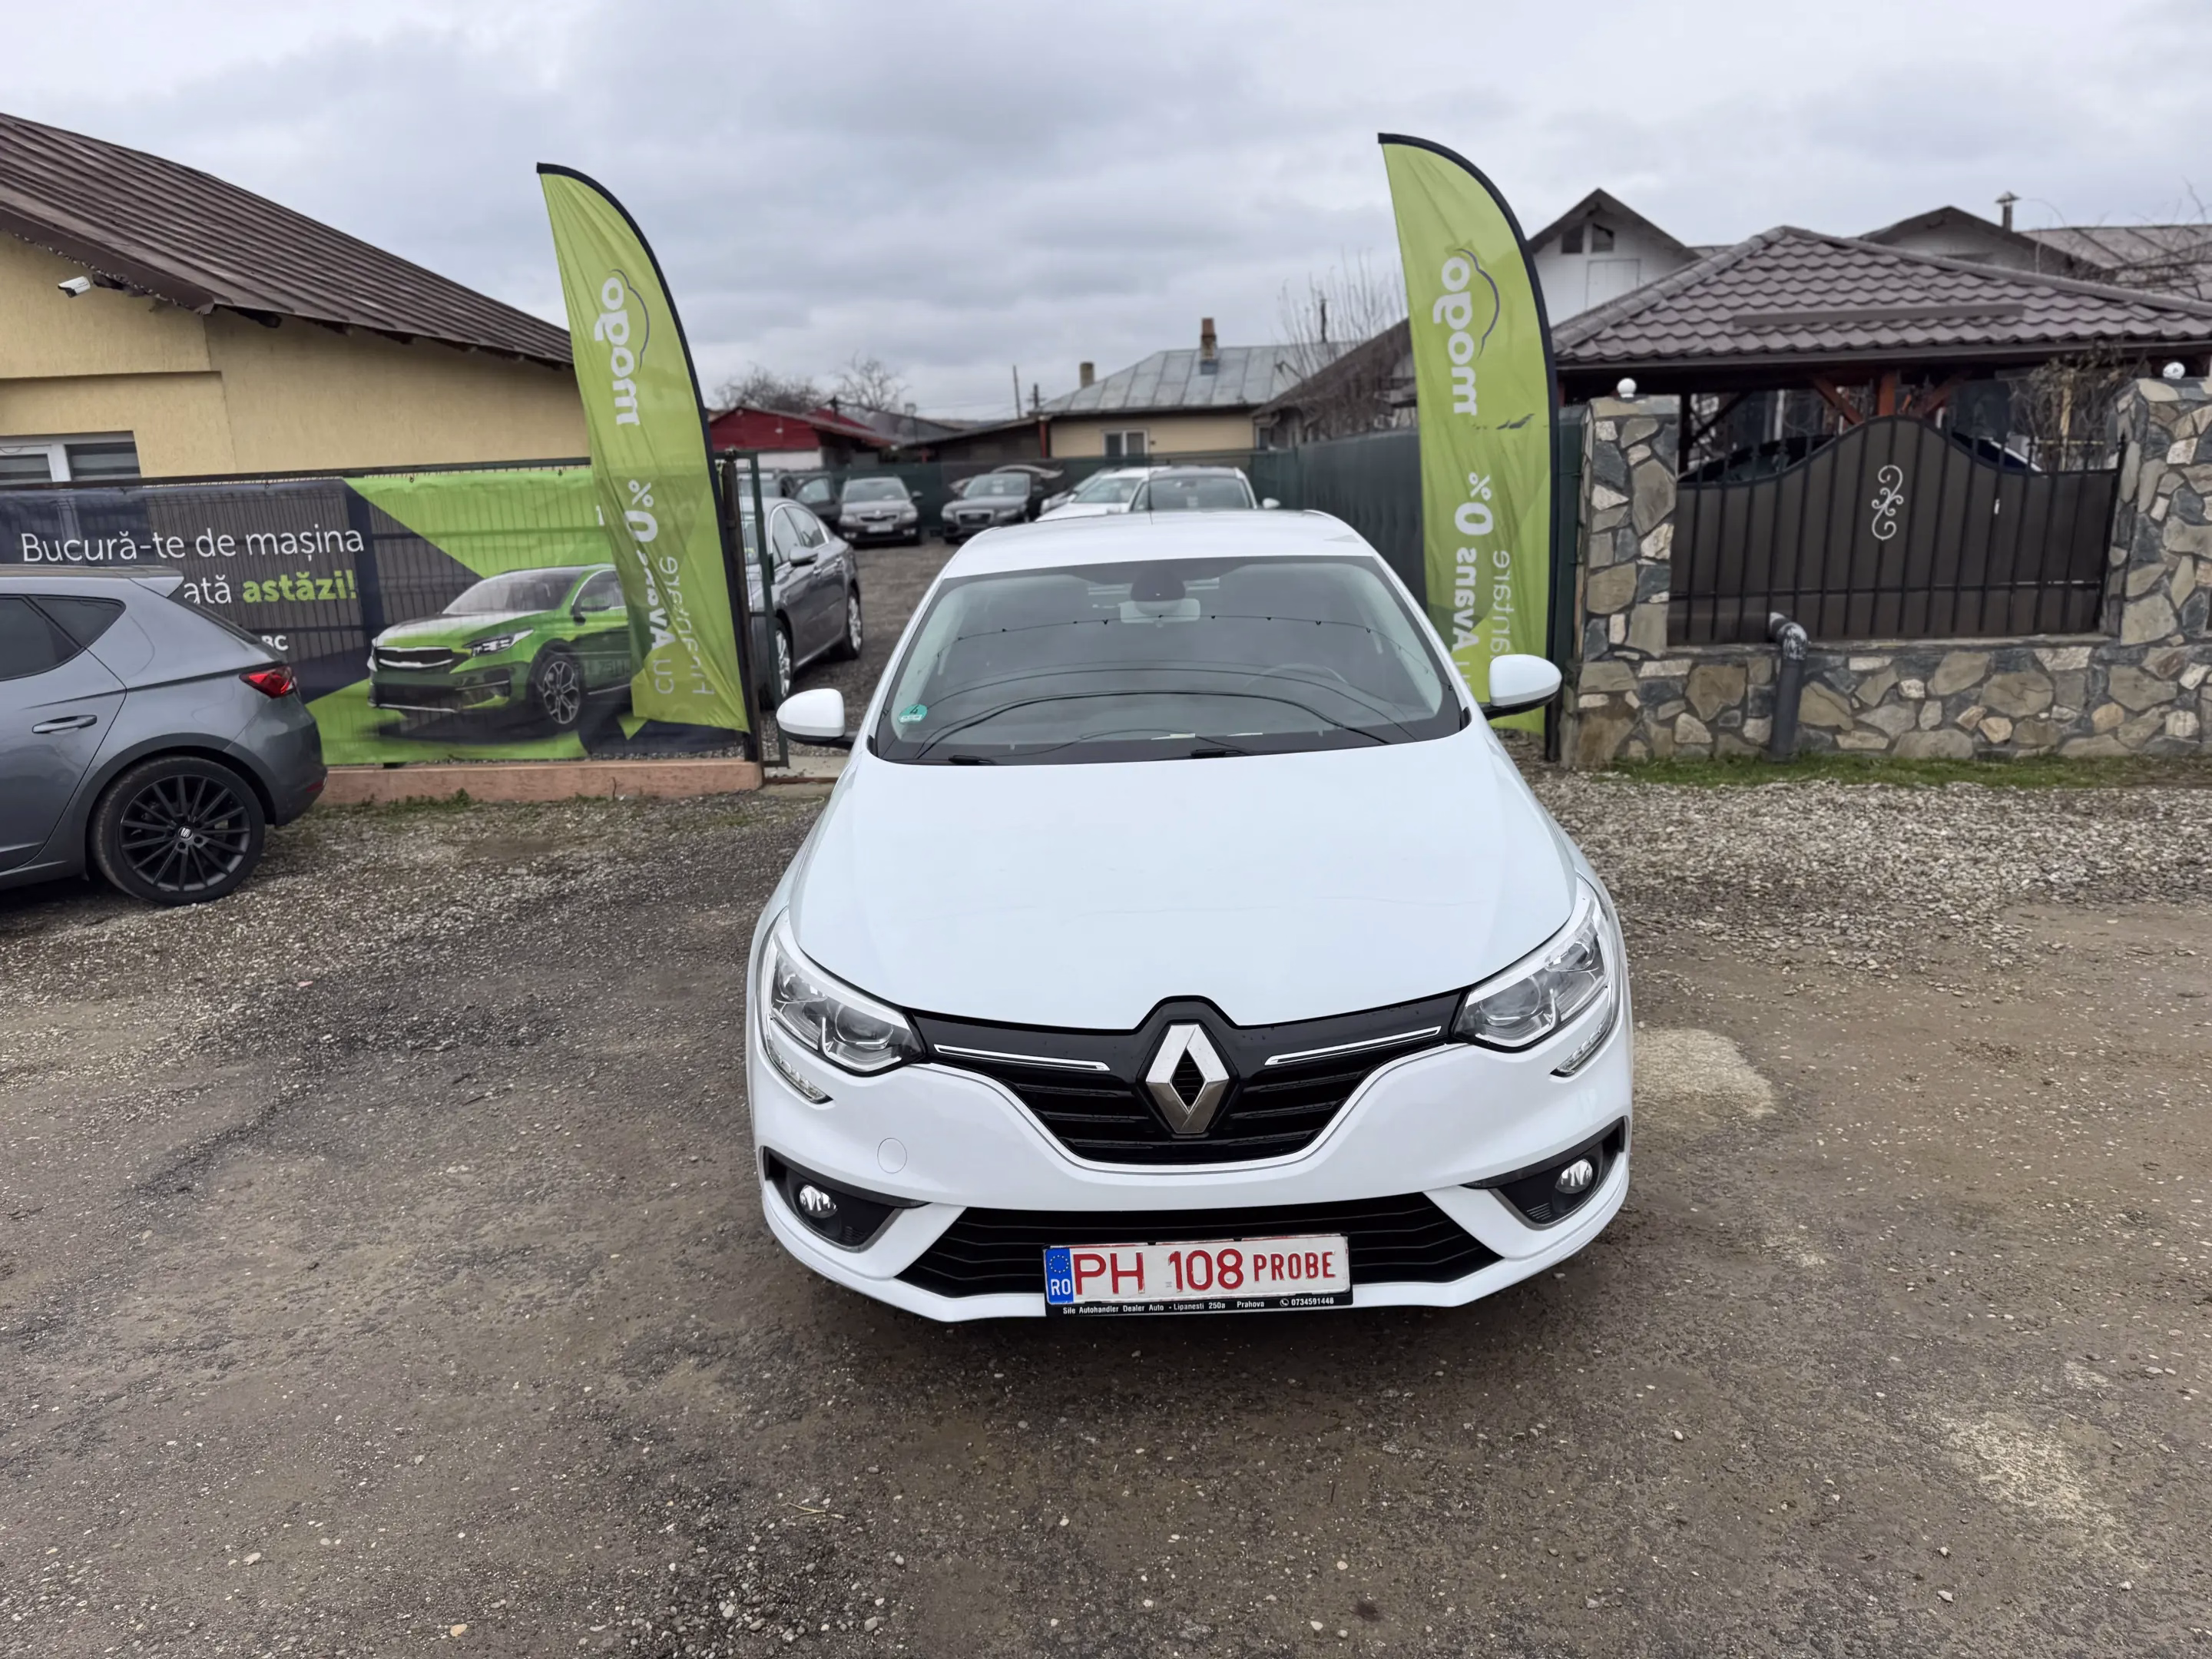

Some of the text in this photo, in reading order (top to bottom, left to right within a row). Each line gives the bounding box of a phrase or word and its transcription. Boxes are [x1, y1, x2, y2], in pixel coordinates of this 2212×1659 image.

[21, 524, 364, 562] Bucură-te de mașina
[184, 569, 357, 604] ată astăzi!
[1050, 1278, 1071, 1296] RO
[1073, 1248, 1336, 1295] PH 108 PROBE
[1079, 1305, 1119, 1313] Autohandler
[1123, 1304, 1144, 1313] Dealer
[1148, 1303, 1164, 1312] Auto
[1174, 1302, 1204, 1311] Lipanesti
[1237, 1300, 1265, 1309] Prahova
